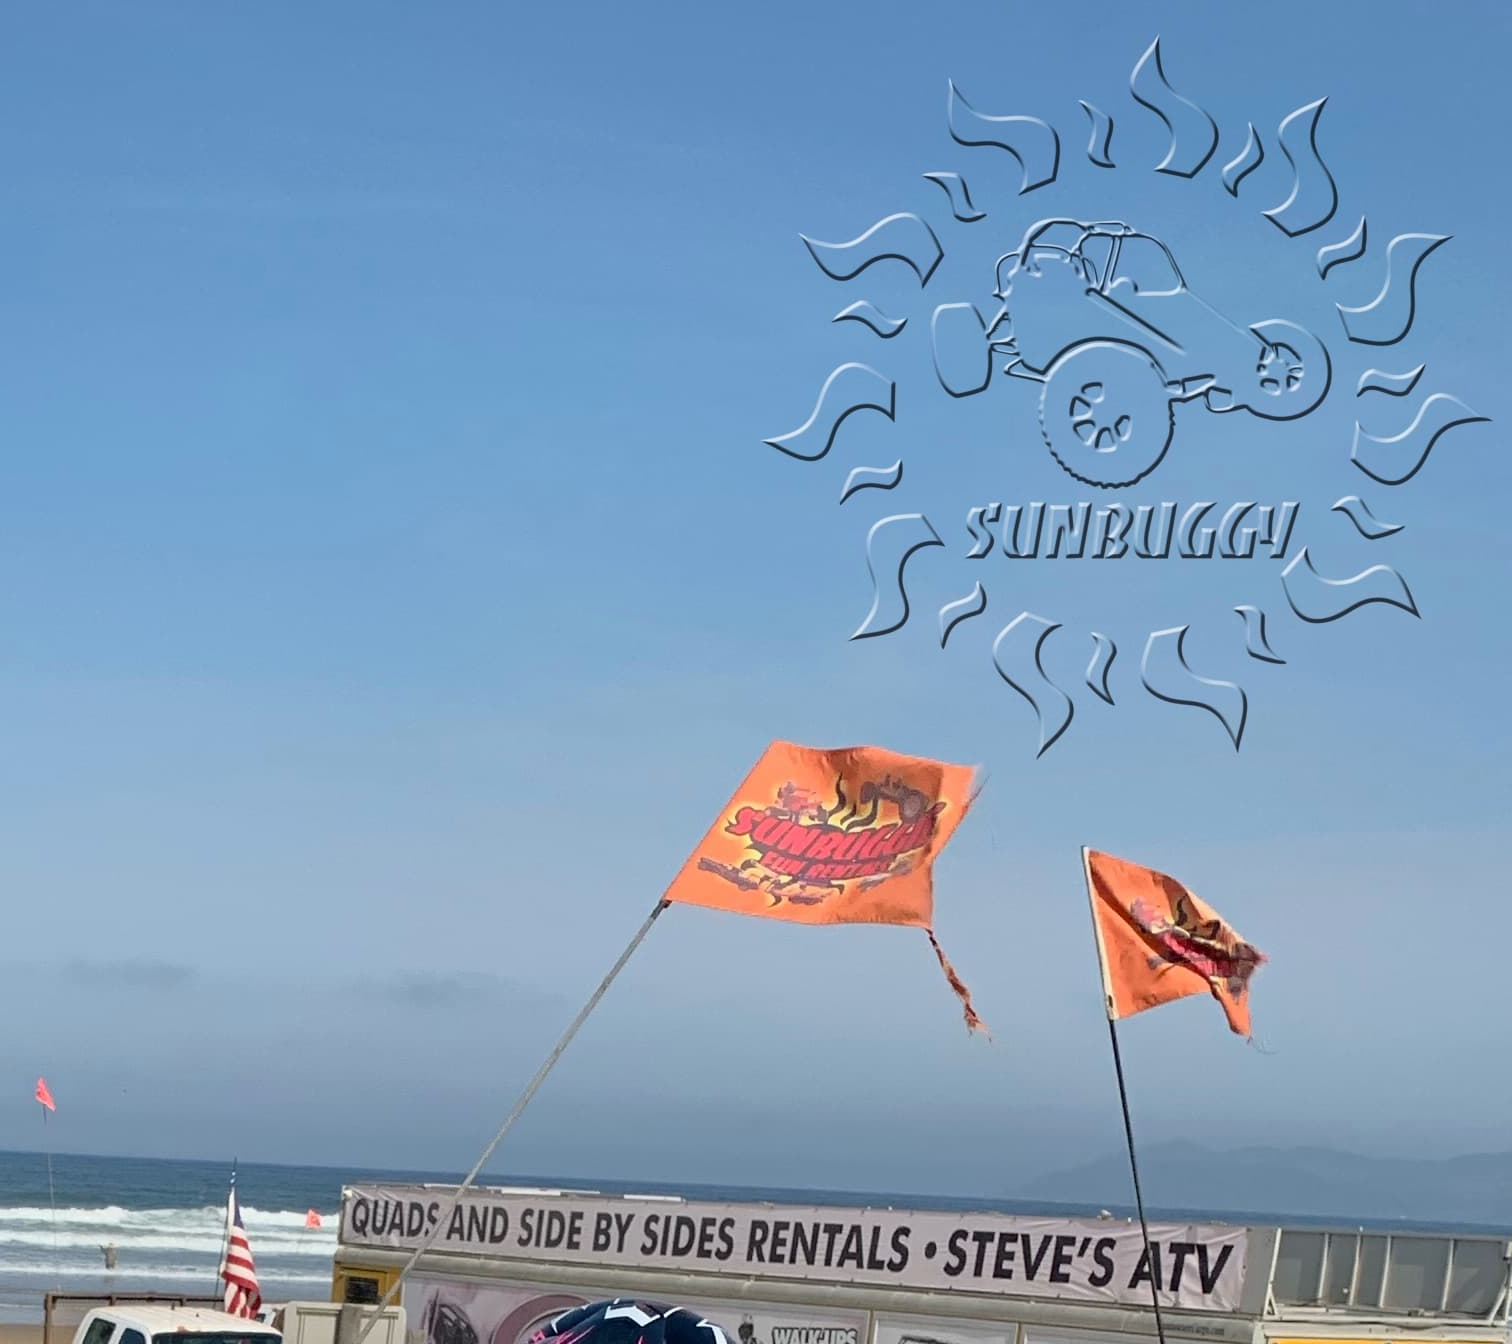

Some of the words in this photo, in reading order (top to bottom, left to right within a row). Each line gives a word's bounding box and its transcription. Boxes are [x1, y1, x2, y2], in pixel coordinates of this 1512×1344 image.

[351, 1197, 440, 1238] QUADS
[446, 1202, 509, 1244] AND
[517, 1207, 585, 1251] SIDE
[593, 1212, 637, 1253] BY
[640, 1213, 736, 1262] SIDES
[746, 1219, 912, 1273] RENTALS
[943, 1229, 1118, 1288] STEVE'S
[1127, 1241, 1234, 1295] ATV
